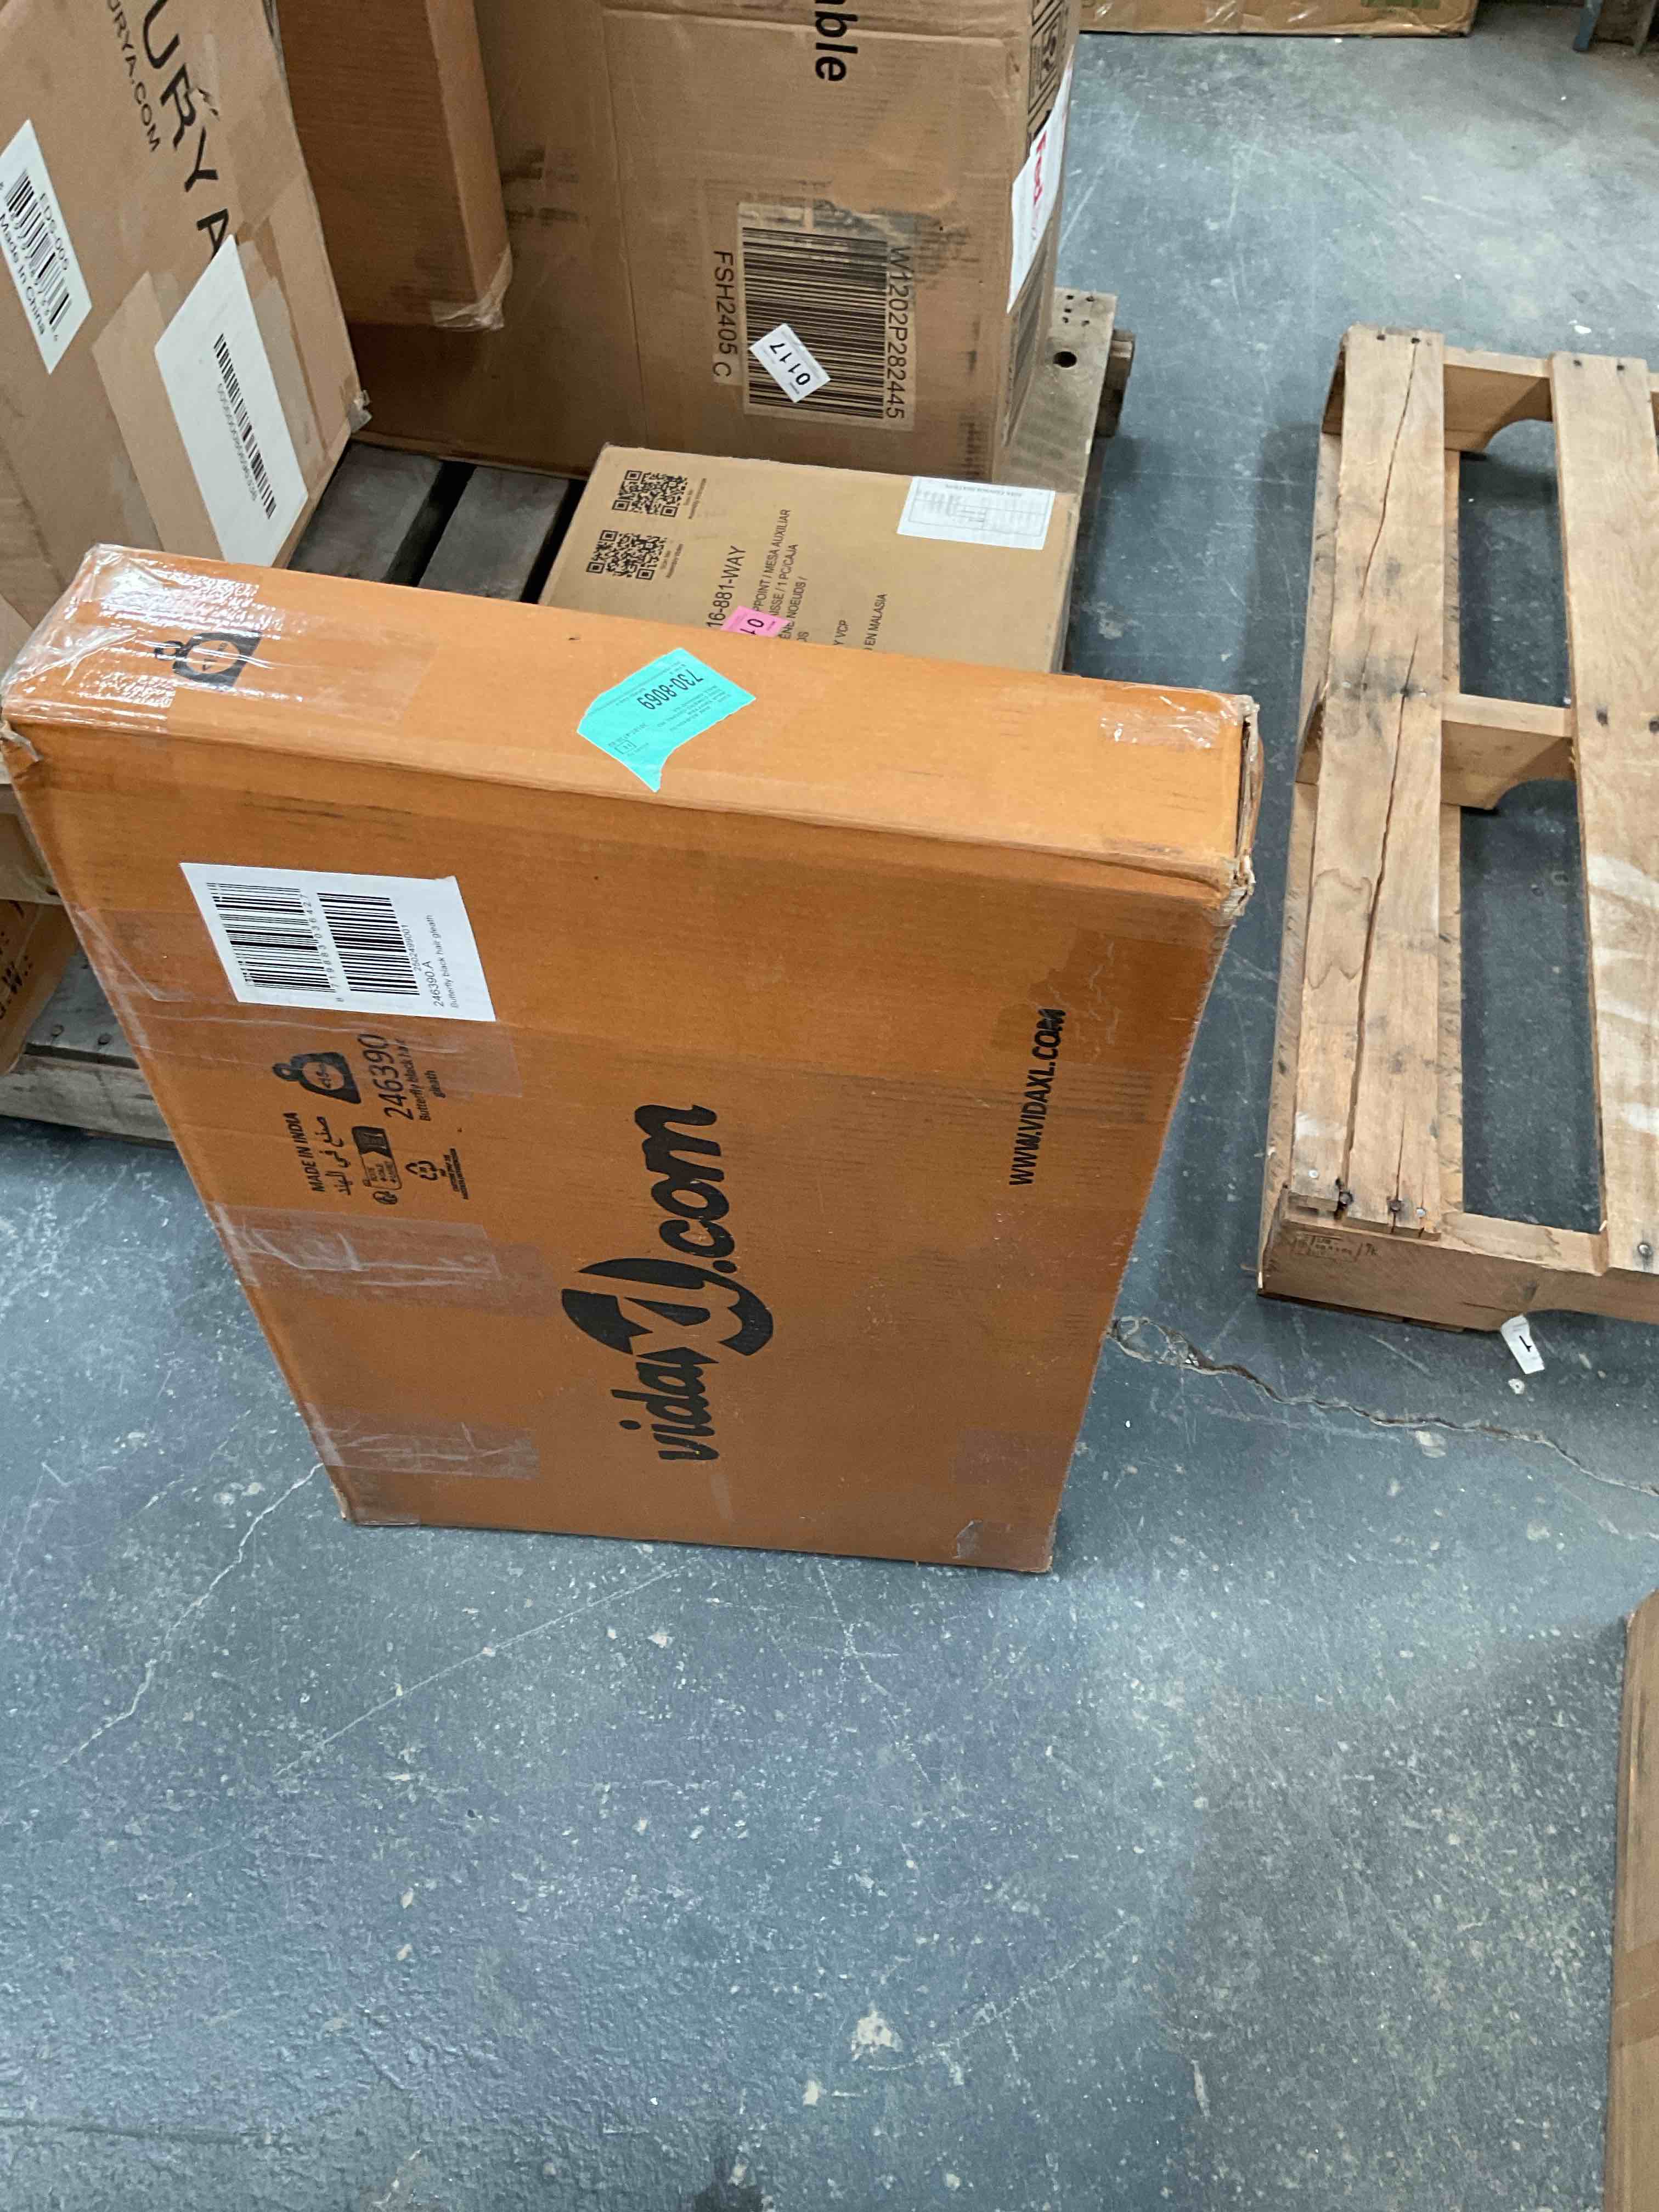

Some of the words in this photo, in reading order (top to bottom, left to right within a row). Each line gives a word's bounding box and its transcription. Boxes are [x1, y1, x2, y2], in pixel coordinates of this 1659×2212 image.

[815, 0, 858, 82] ble
[714, 250, 738, 356] FSH2405
[887, 245, 912, 420] W1202P282445
[769, 343, 810, 385] 0117
[771, 509, 791, 547] AUXILIAR
[764, 549, 780, 573] MESA
[779, 544, 798, 580] PC/CAJA
[786, 582, 806, 619] NOEUDS
[867, 594, 887, 631] MALASIA
[636, 669, 704, 710] 730-8069
[422, 961, 443, 1007] 246390.A
[357, 1034, 414, 1120] 246390
[1009, 1008, 1066, 1185] WWW.VIDAXL.COM
[283, 1112, 308, 1144] INDIA
[295, 1146, 314, 1159] IN
[302, 1160, 325, 1192] MADE
